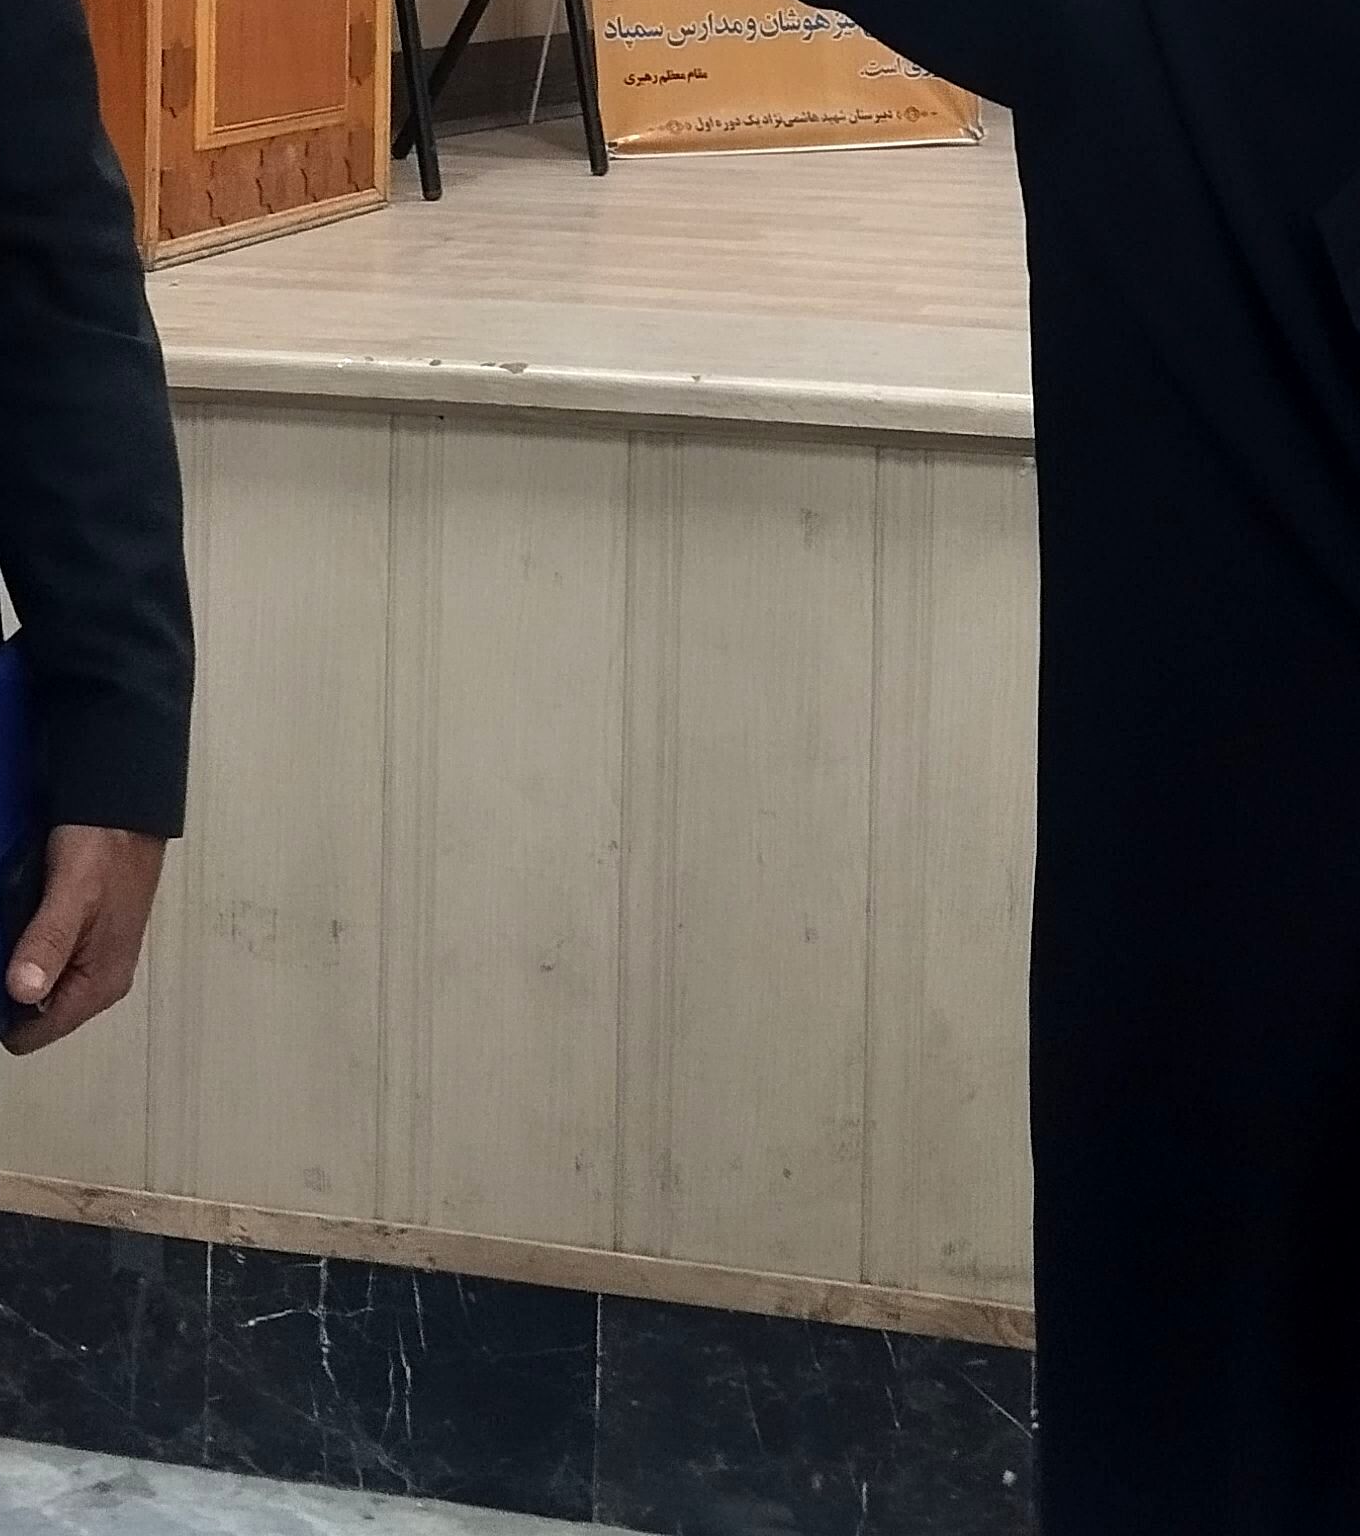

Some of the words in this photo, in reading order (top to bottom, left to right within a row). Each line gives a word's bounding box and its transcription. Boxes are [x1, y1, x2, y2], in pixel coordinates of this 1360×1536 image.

[604, 15, 664, 49] سمپاد
[666, 12, 744, 47] مدارس
[745, 19, 758, 42] و
[623, 72, 659, 87] رهبری
[659, 69, 686, 85] معظم
[687, 67, 709, 83] مقام
[694, 117, 713, 132] اول
[821, 110, 846, 125] شهید
[848, 108, 893, 125] دبیرستان
